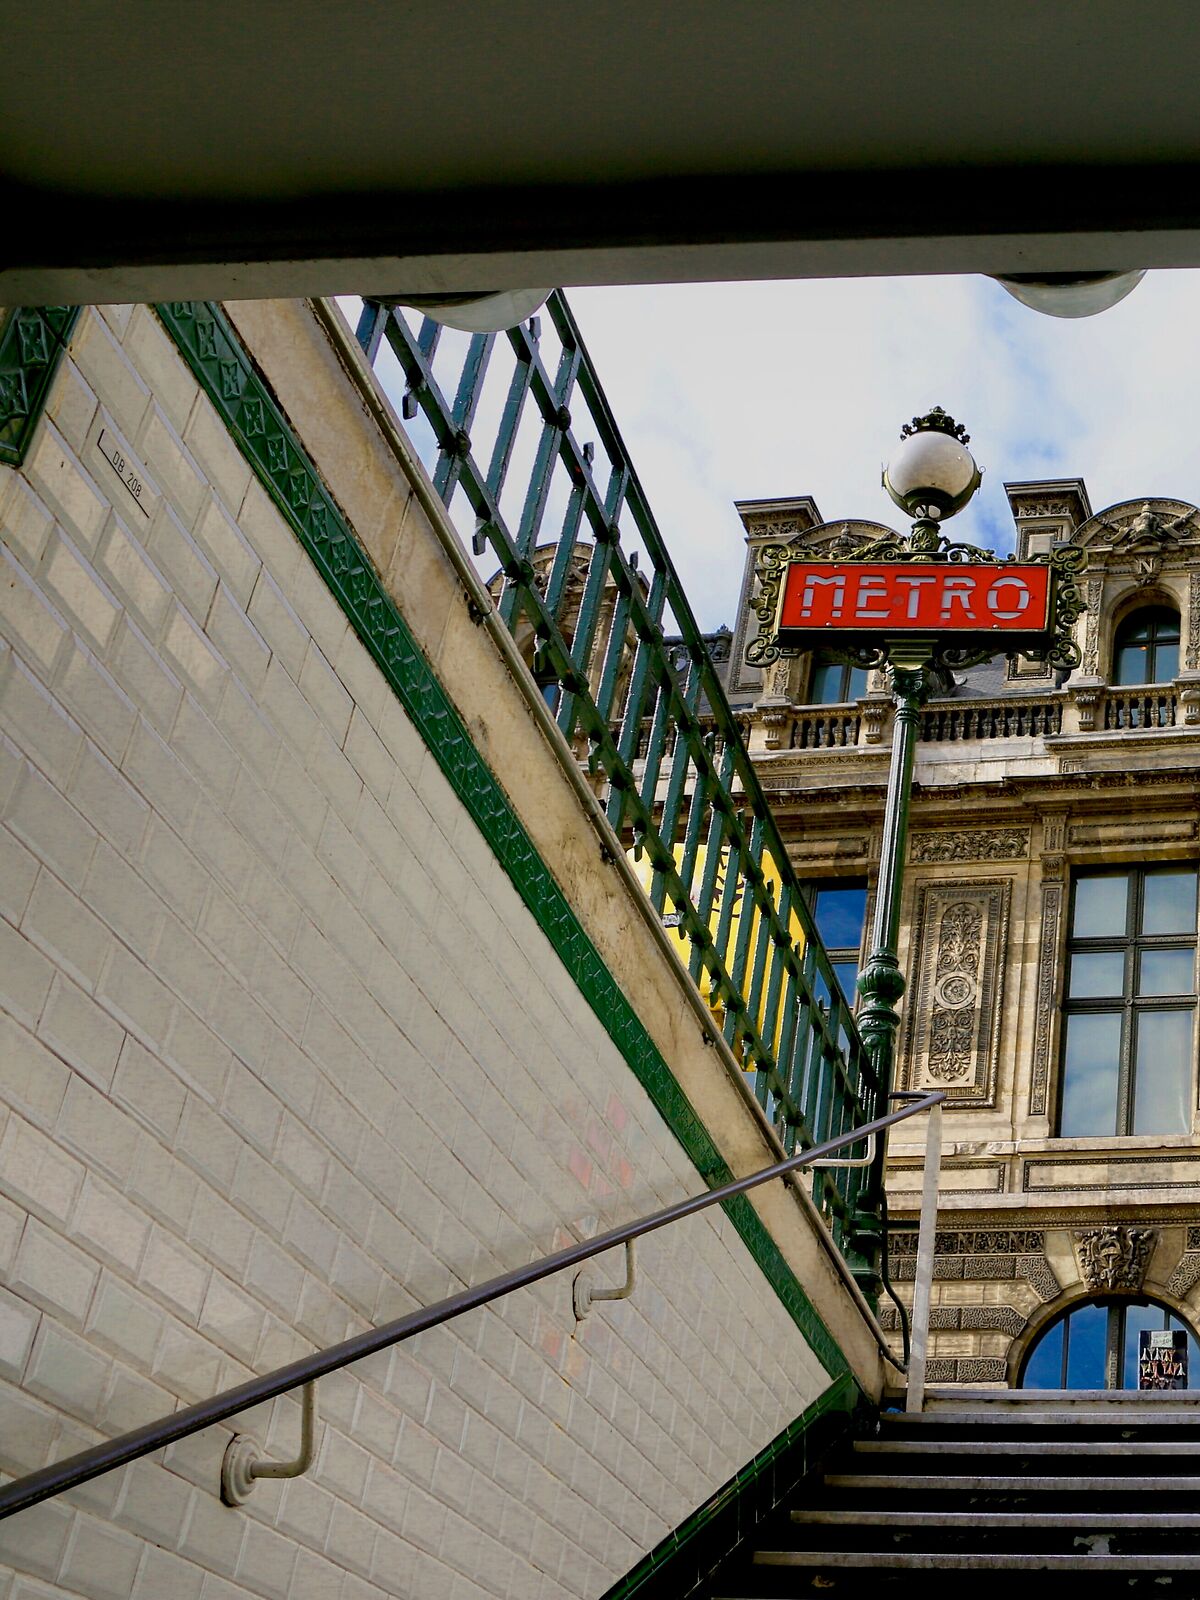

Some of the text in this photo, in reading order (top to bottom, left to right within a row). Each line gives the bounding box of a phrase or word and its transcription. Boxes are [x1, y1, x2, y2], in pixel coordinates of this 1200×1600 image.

[126, 473, 142, 497] 208
[1139, 558, 1154, 574] N
[800, 575, 1030, 620] METRO
